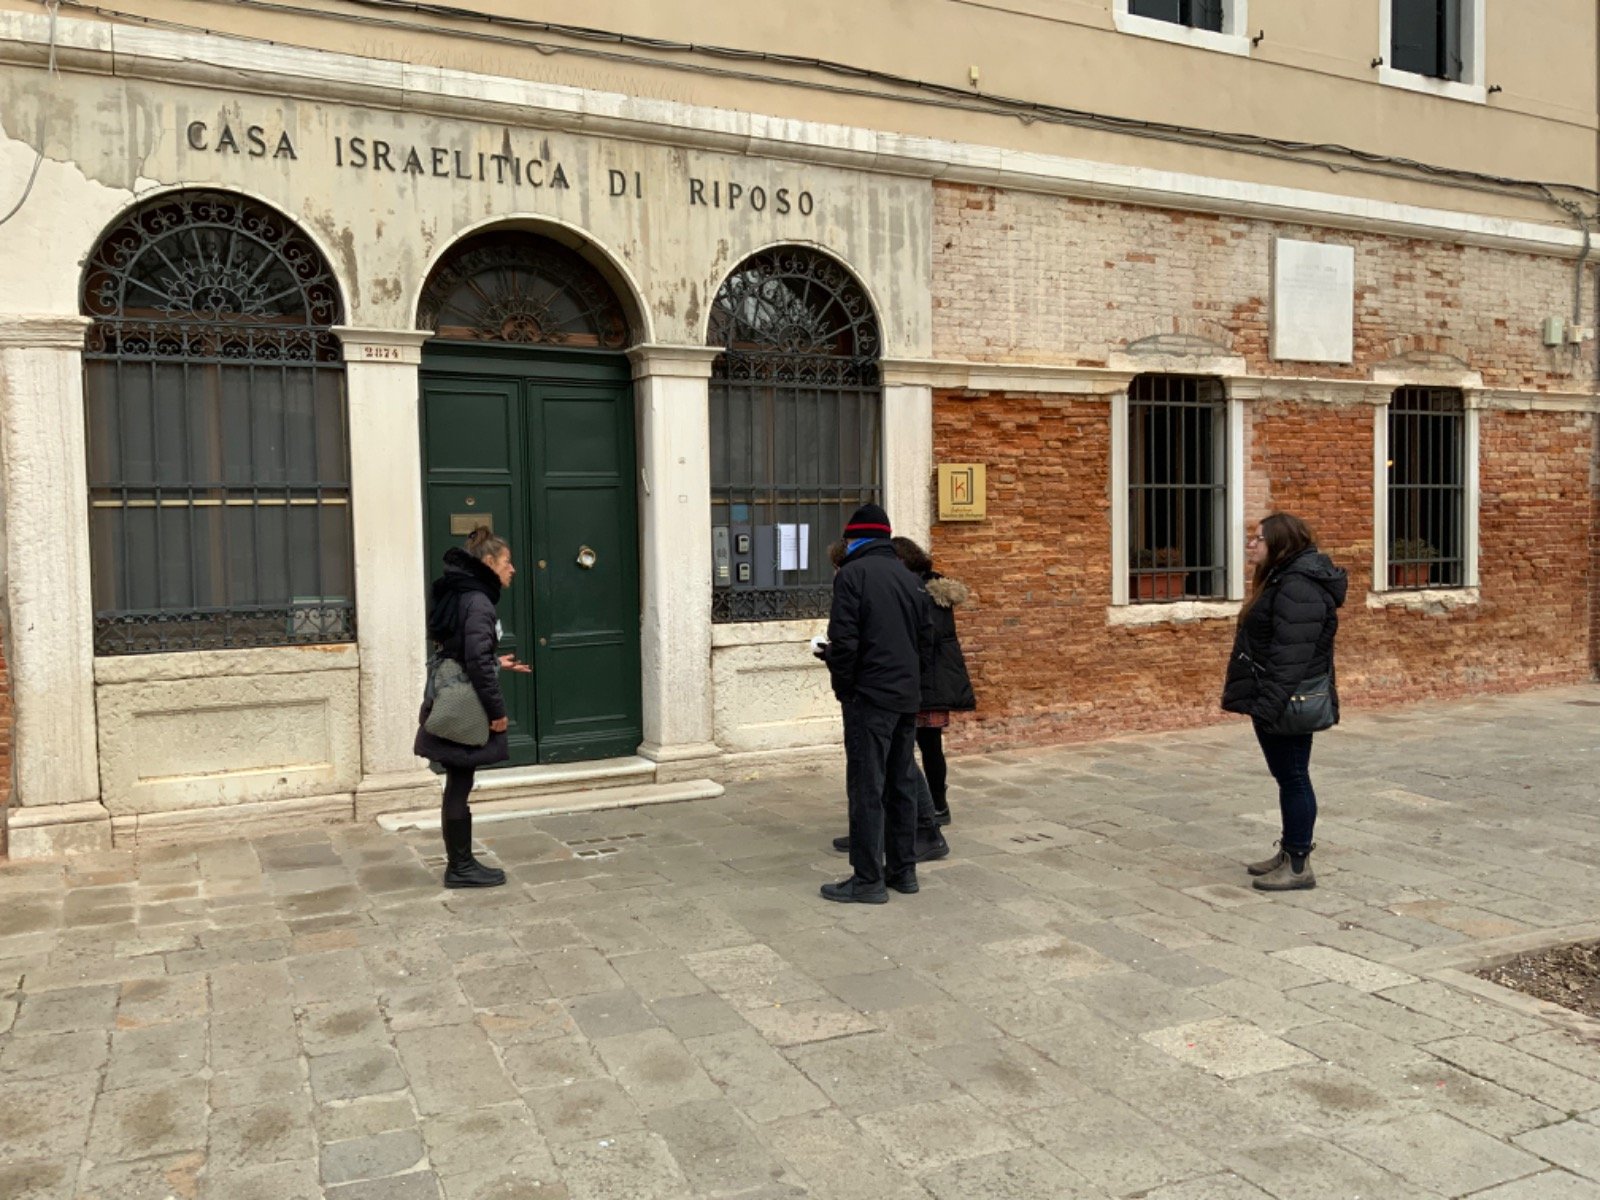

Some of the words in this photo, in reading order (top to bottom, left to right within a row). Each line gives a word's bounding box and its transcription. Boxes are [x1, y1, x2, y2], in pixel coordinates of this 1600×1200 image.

[187, 121, 297, 160] CASA
[335, 136, 570, 189] ISRAELITICA
[608, 169, 642, 199] DI
[689, 178, 814, 216] RIPOSO
[364, 346, 399, 359] 2874
